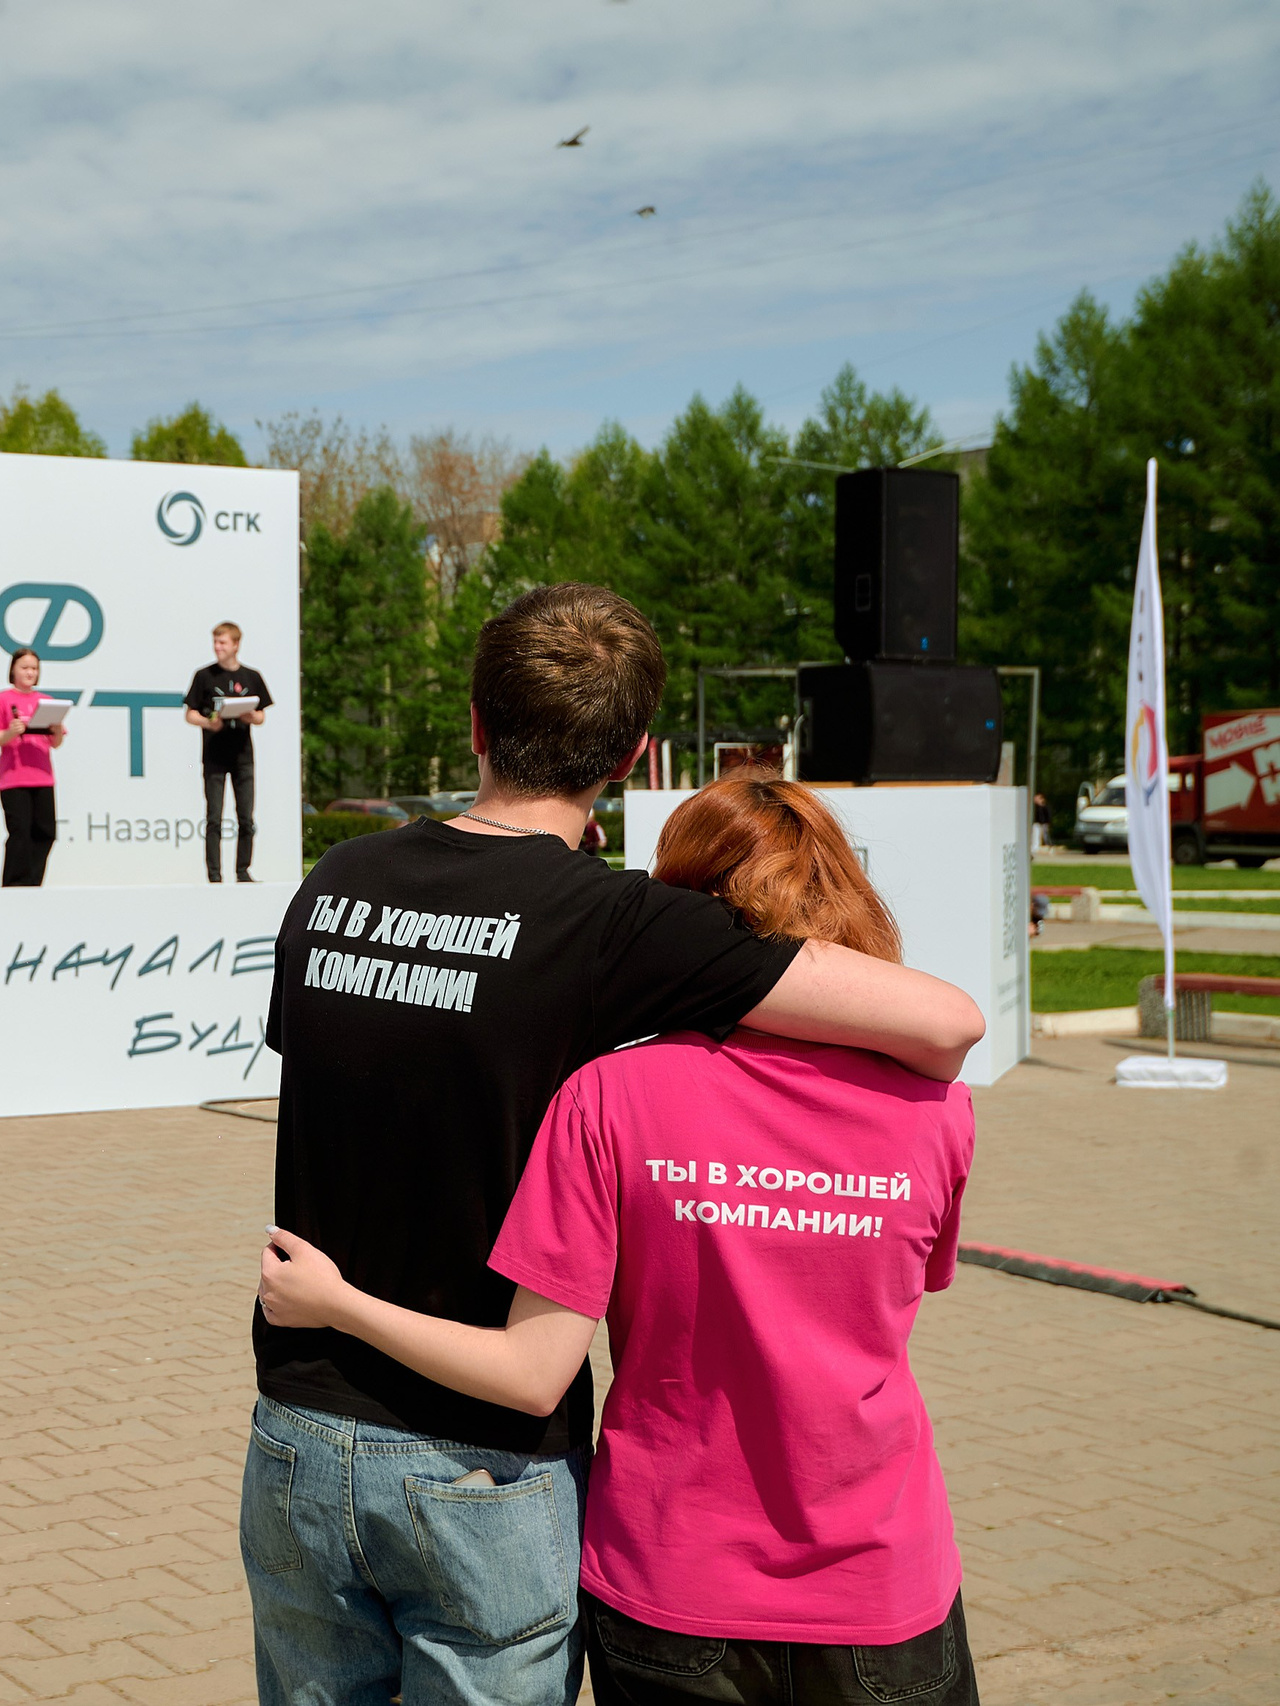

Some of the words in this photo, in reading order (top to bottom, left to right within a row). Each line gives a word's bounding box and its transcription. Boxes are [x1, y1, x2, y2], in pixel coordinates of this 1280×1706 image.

[215, 511, 261, 533] СГК
[87, 812, 257, 848] Назаров
[306, 895, 349, 934] ТЫ
[343, 900, 371, 938] В
[368, 906, 521, 960] ХОРОШЕЙ
[304, 947, 478, 1013] КОМПАНИИ!
[645, 1159, 697, 1183] ТЫ
[708, 1161, 727, 1185] В
[735, 1164, 911, 1201] ХОРОШЕЙ
[674, 1199, 883, 1238] КОМПАНИИ!
